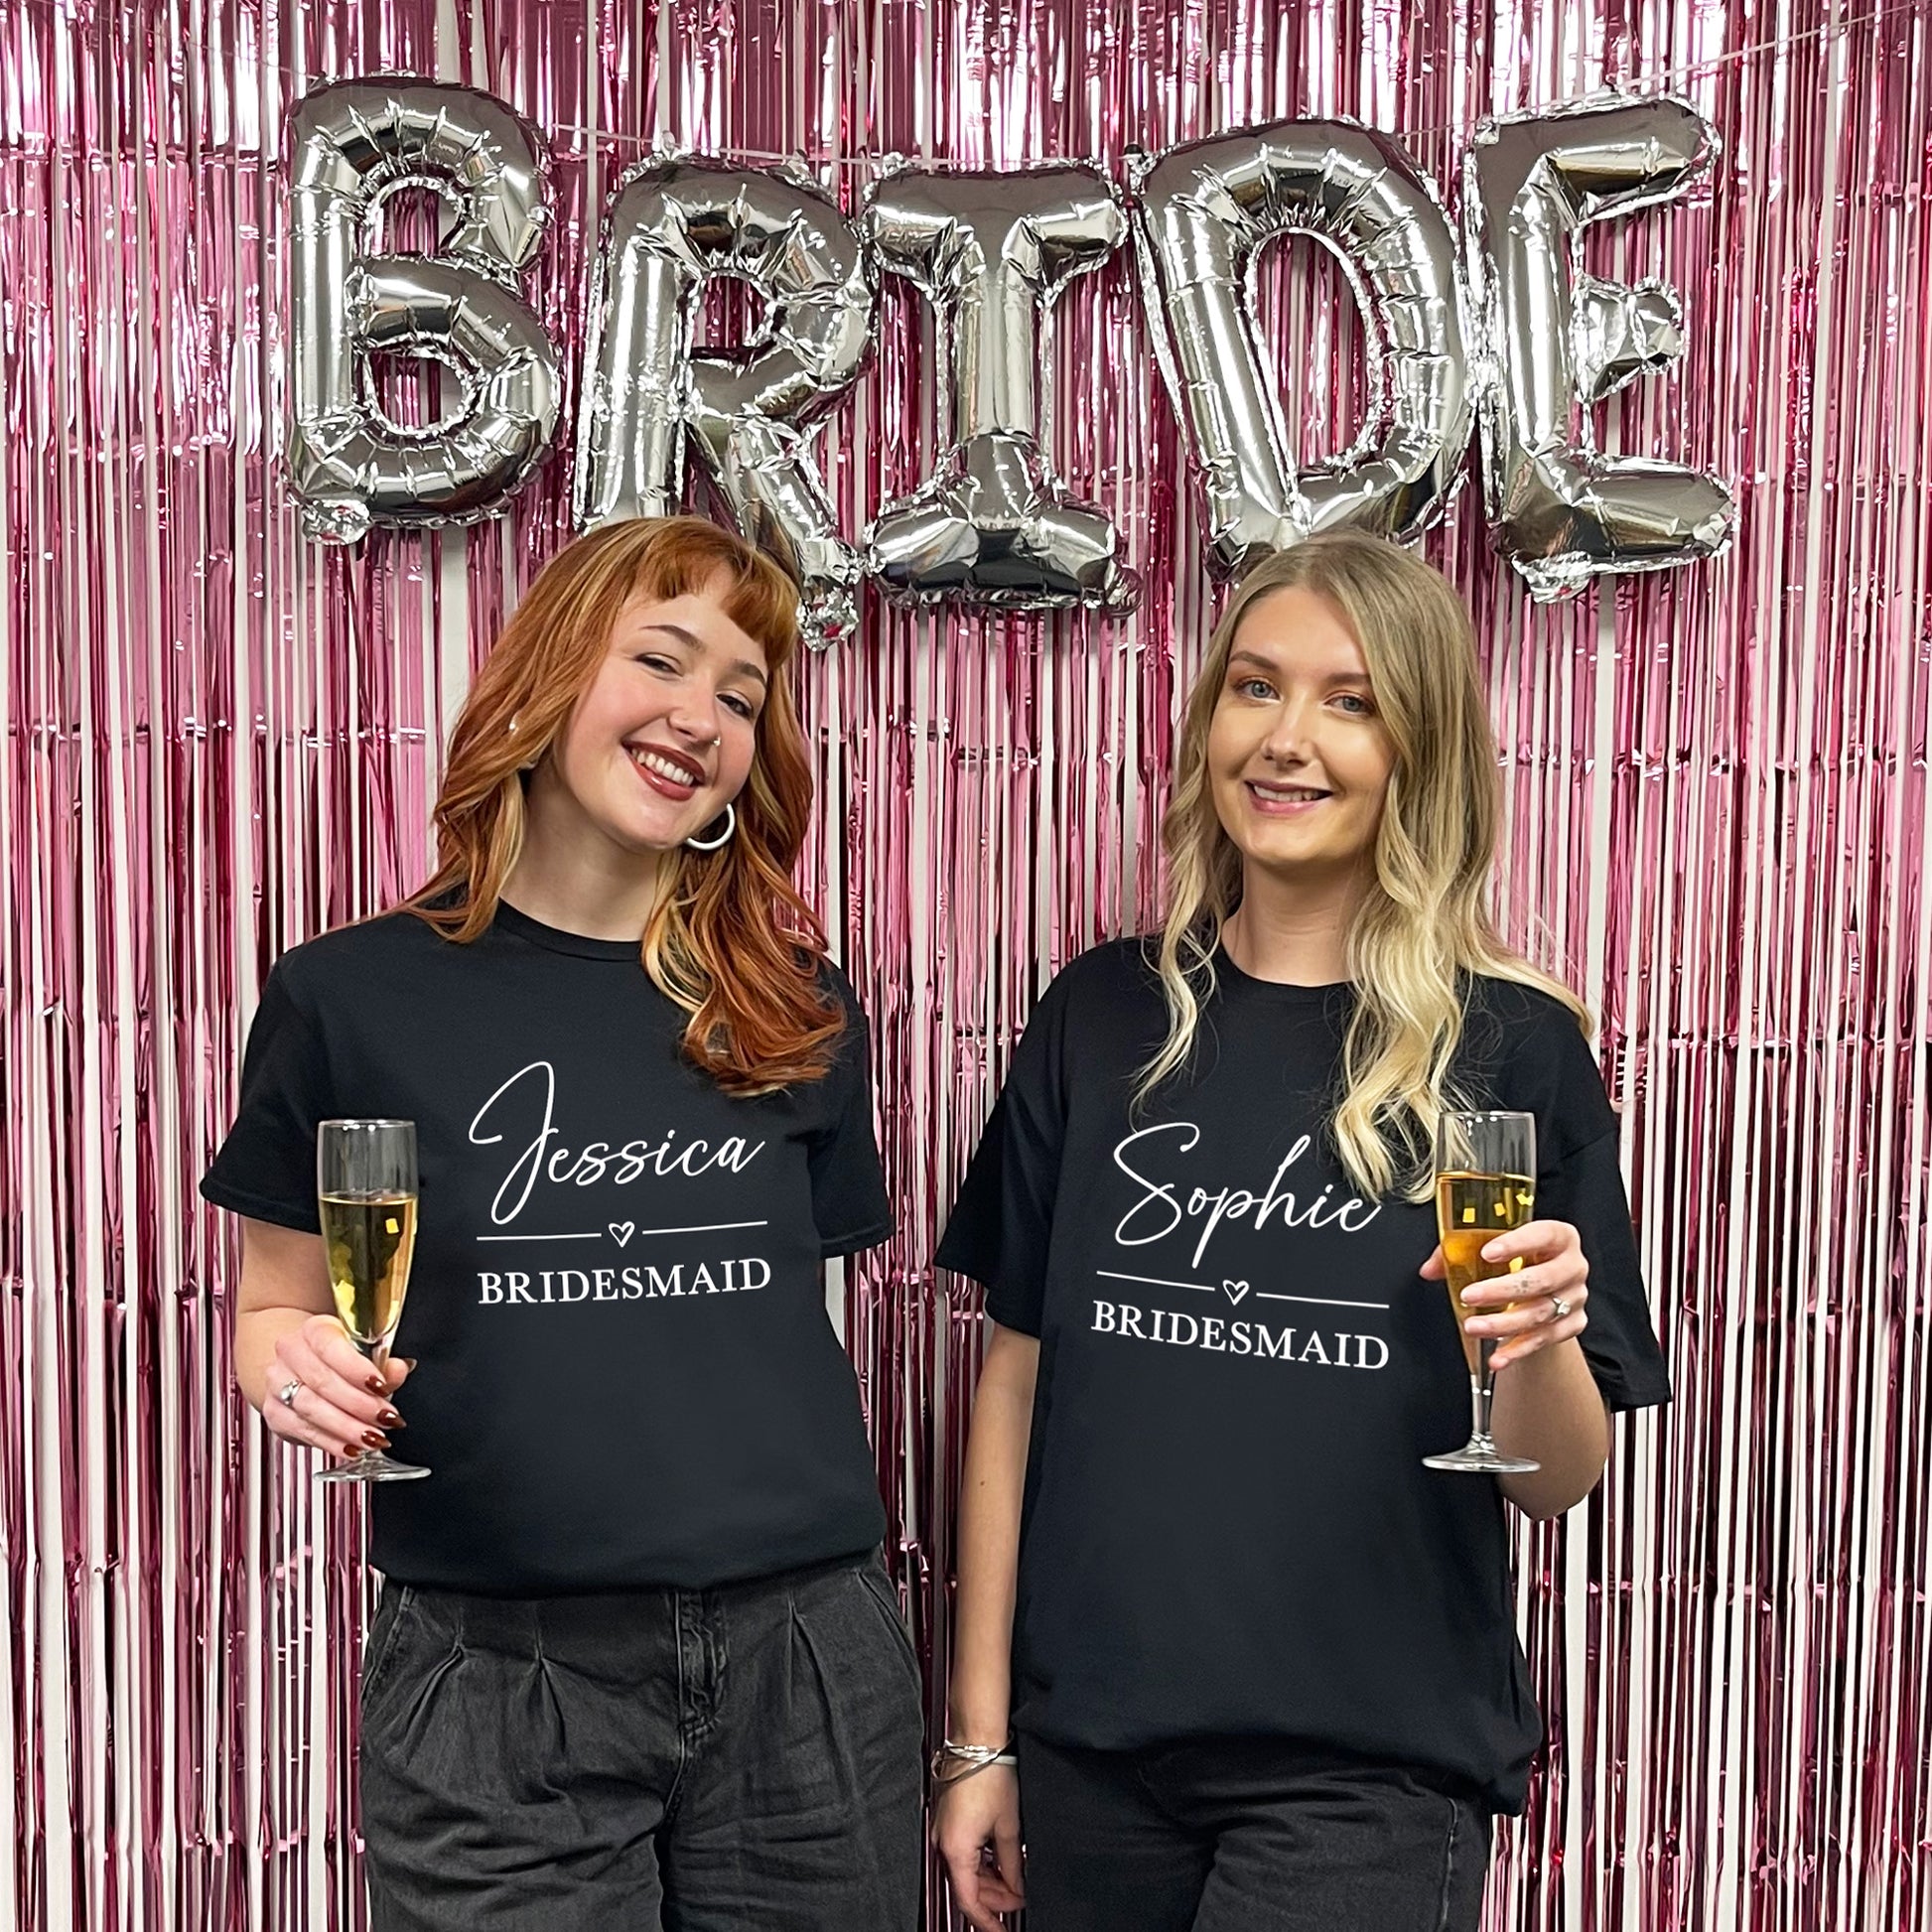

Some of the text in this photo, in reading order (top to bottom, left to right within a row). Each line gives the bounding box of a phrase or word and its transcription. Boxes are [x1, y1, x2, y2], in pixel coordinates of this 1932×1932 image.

[282, 71, 1736, 635] BRIDE
[468, 1060, 766, 1225] Jessica
[1113, 1122, 1383, 1270] Sophie
[477, 1257, 771, 1305] BRIDESMAID
[1090, 1300, 1390, 1370] BRIDESMAID
